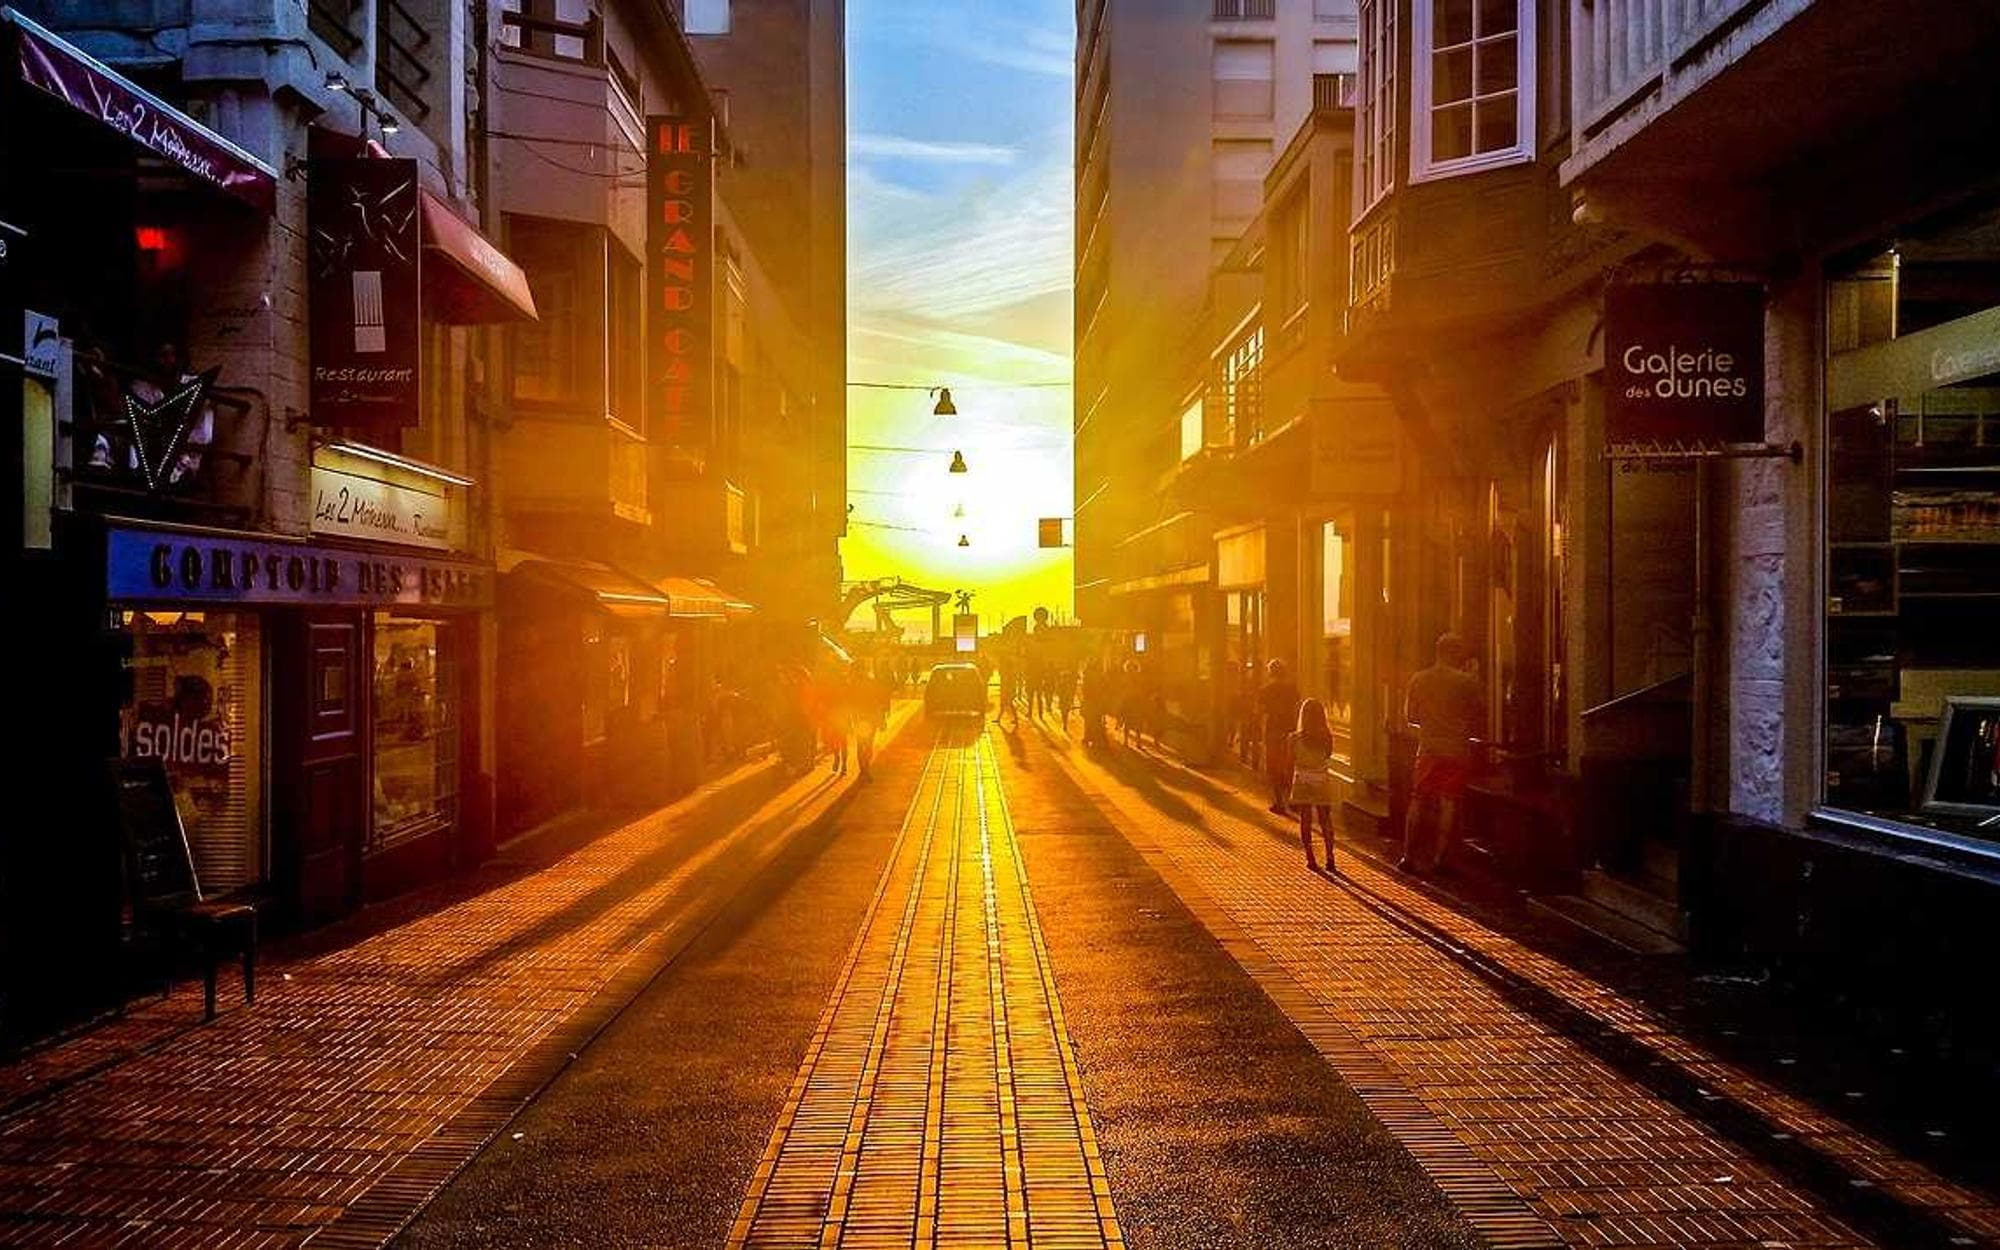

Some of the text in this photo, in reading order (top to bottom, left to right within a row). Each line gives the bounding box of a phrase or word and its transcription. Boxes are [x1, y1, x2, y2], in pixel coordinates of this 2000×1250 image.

[131, 103, 147, 144] 2
[663, 169, 695, 311] GRAND
[315, 366, 413, 383] Restaurant
[1623, 344, 1734, 375] Galerie
[1625, 374, 1746, 399] des dunes
[337, 486, 350, 524] 2
[151, 543, 341, 595] COMPTOIR
[358, 559, 402, 595] DES
[135, 712, 231, 765] soldes
